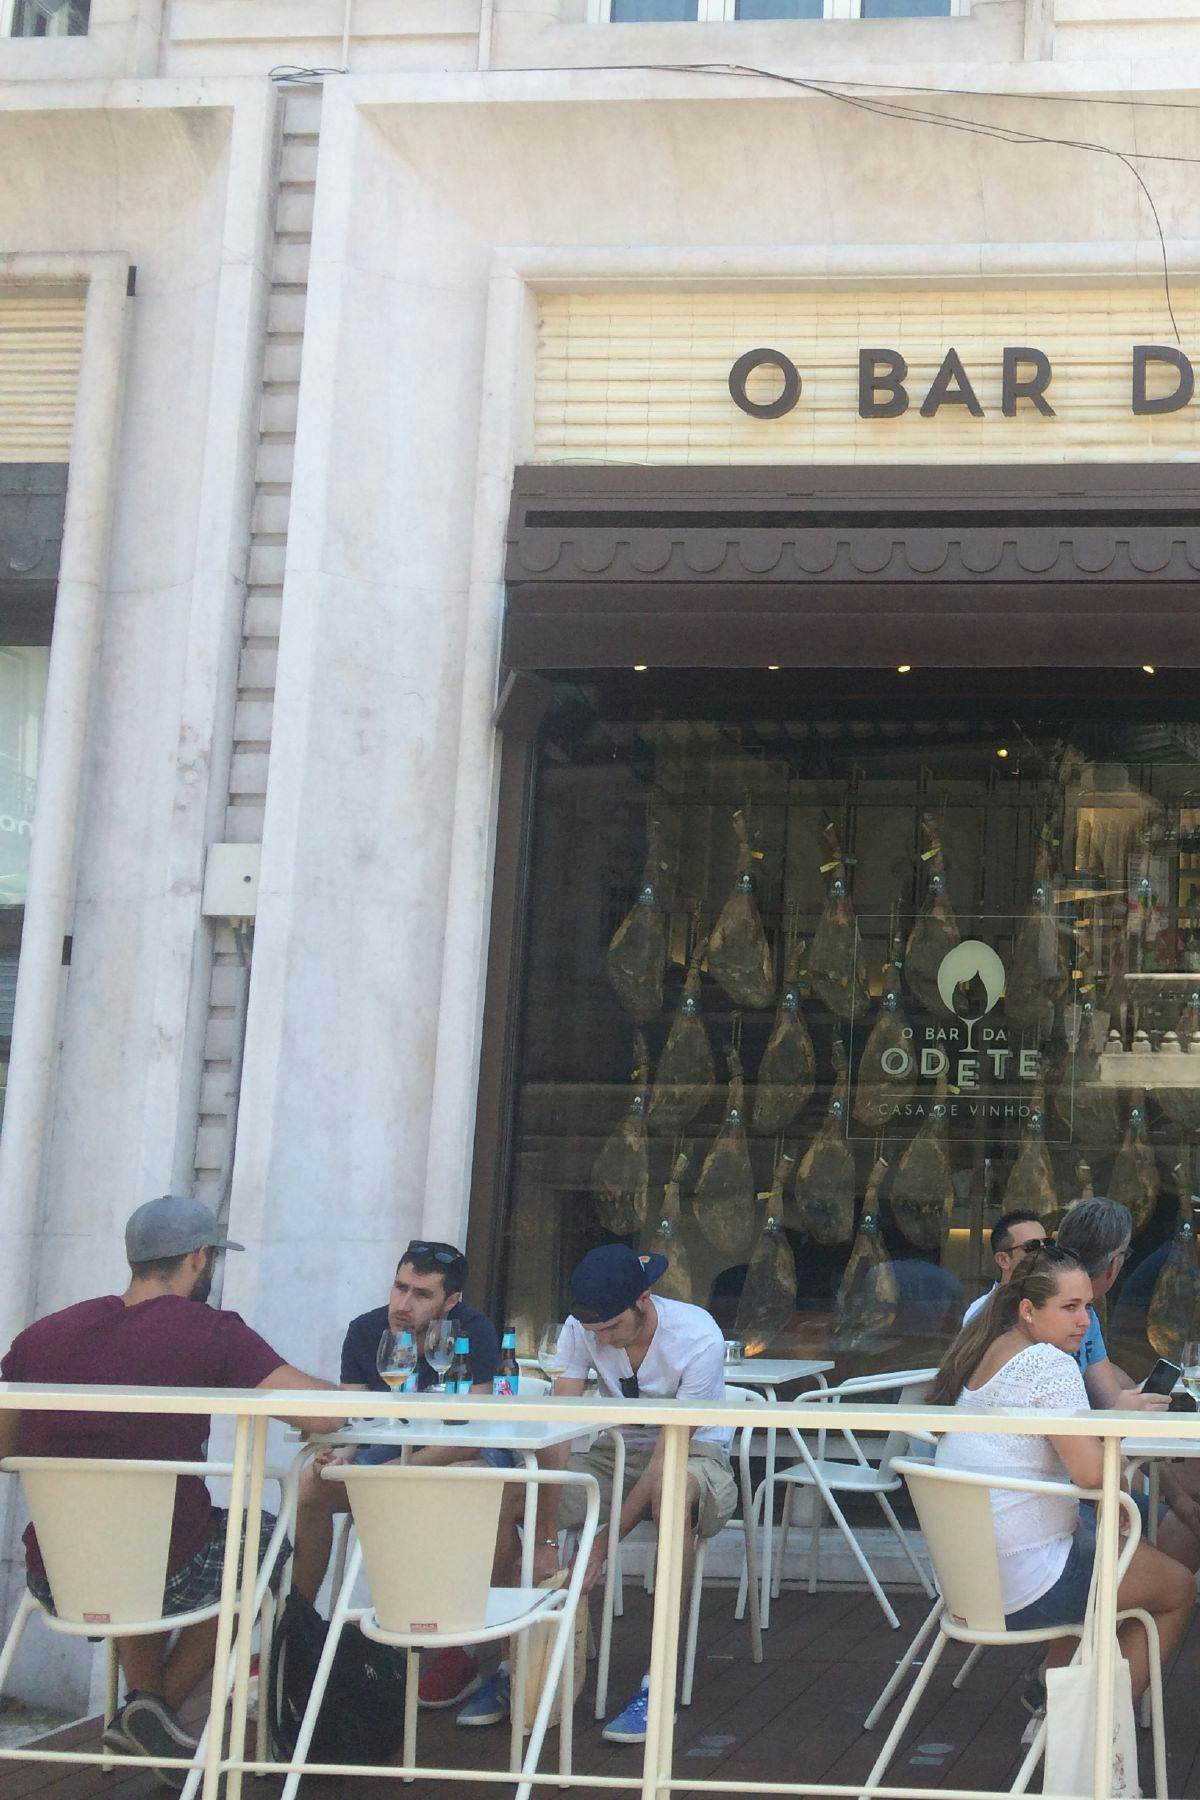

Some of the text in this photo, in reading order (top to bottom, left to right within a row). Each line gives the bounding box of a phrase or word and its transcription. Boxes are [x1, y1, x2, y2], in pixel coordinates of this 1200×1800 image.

[728, 347, 802, 420] O
[858, 346, 1057, 418] BAR
[902, 1028, 1007, 1041] O BAR DA
[881, 1048, 1042, 1089] ODETE
[878, 1103, 926, 1116] CASA
[938, 1104, 958, 1116] DE
[970, 1104, 1042, 1117] VINHOS
